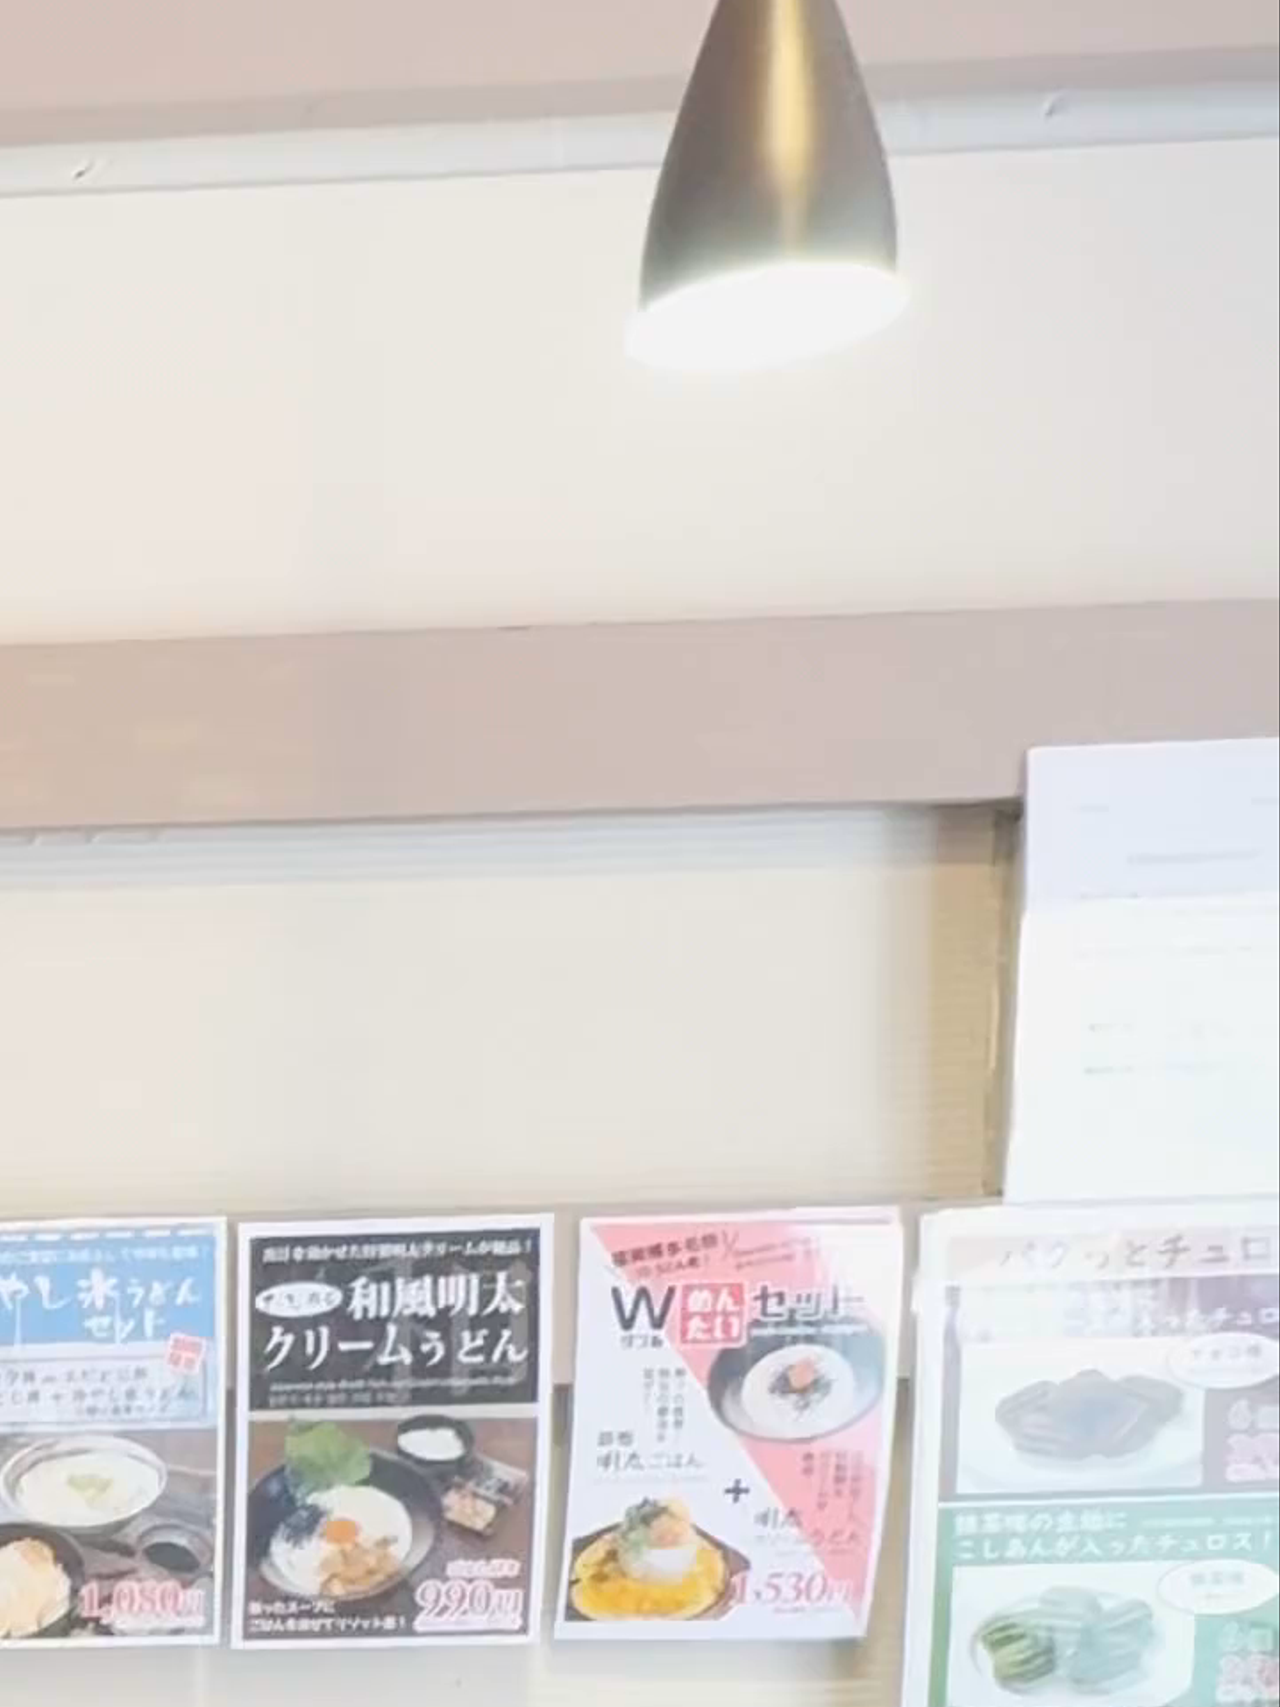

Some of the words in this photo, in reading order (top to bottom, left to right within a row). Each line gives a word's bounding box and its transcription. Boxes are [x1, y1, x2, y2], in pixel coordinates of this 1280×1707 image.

[347, 1270, 526, 1321] 和風明太
[611, 1286, 677, 1332] W
[263, 1321, 529, 1371] クリームうどん
